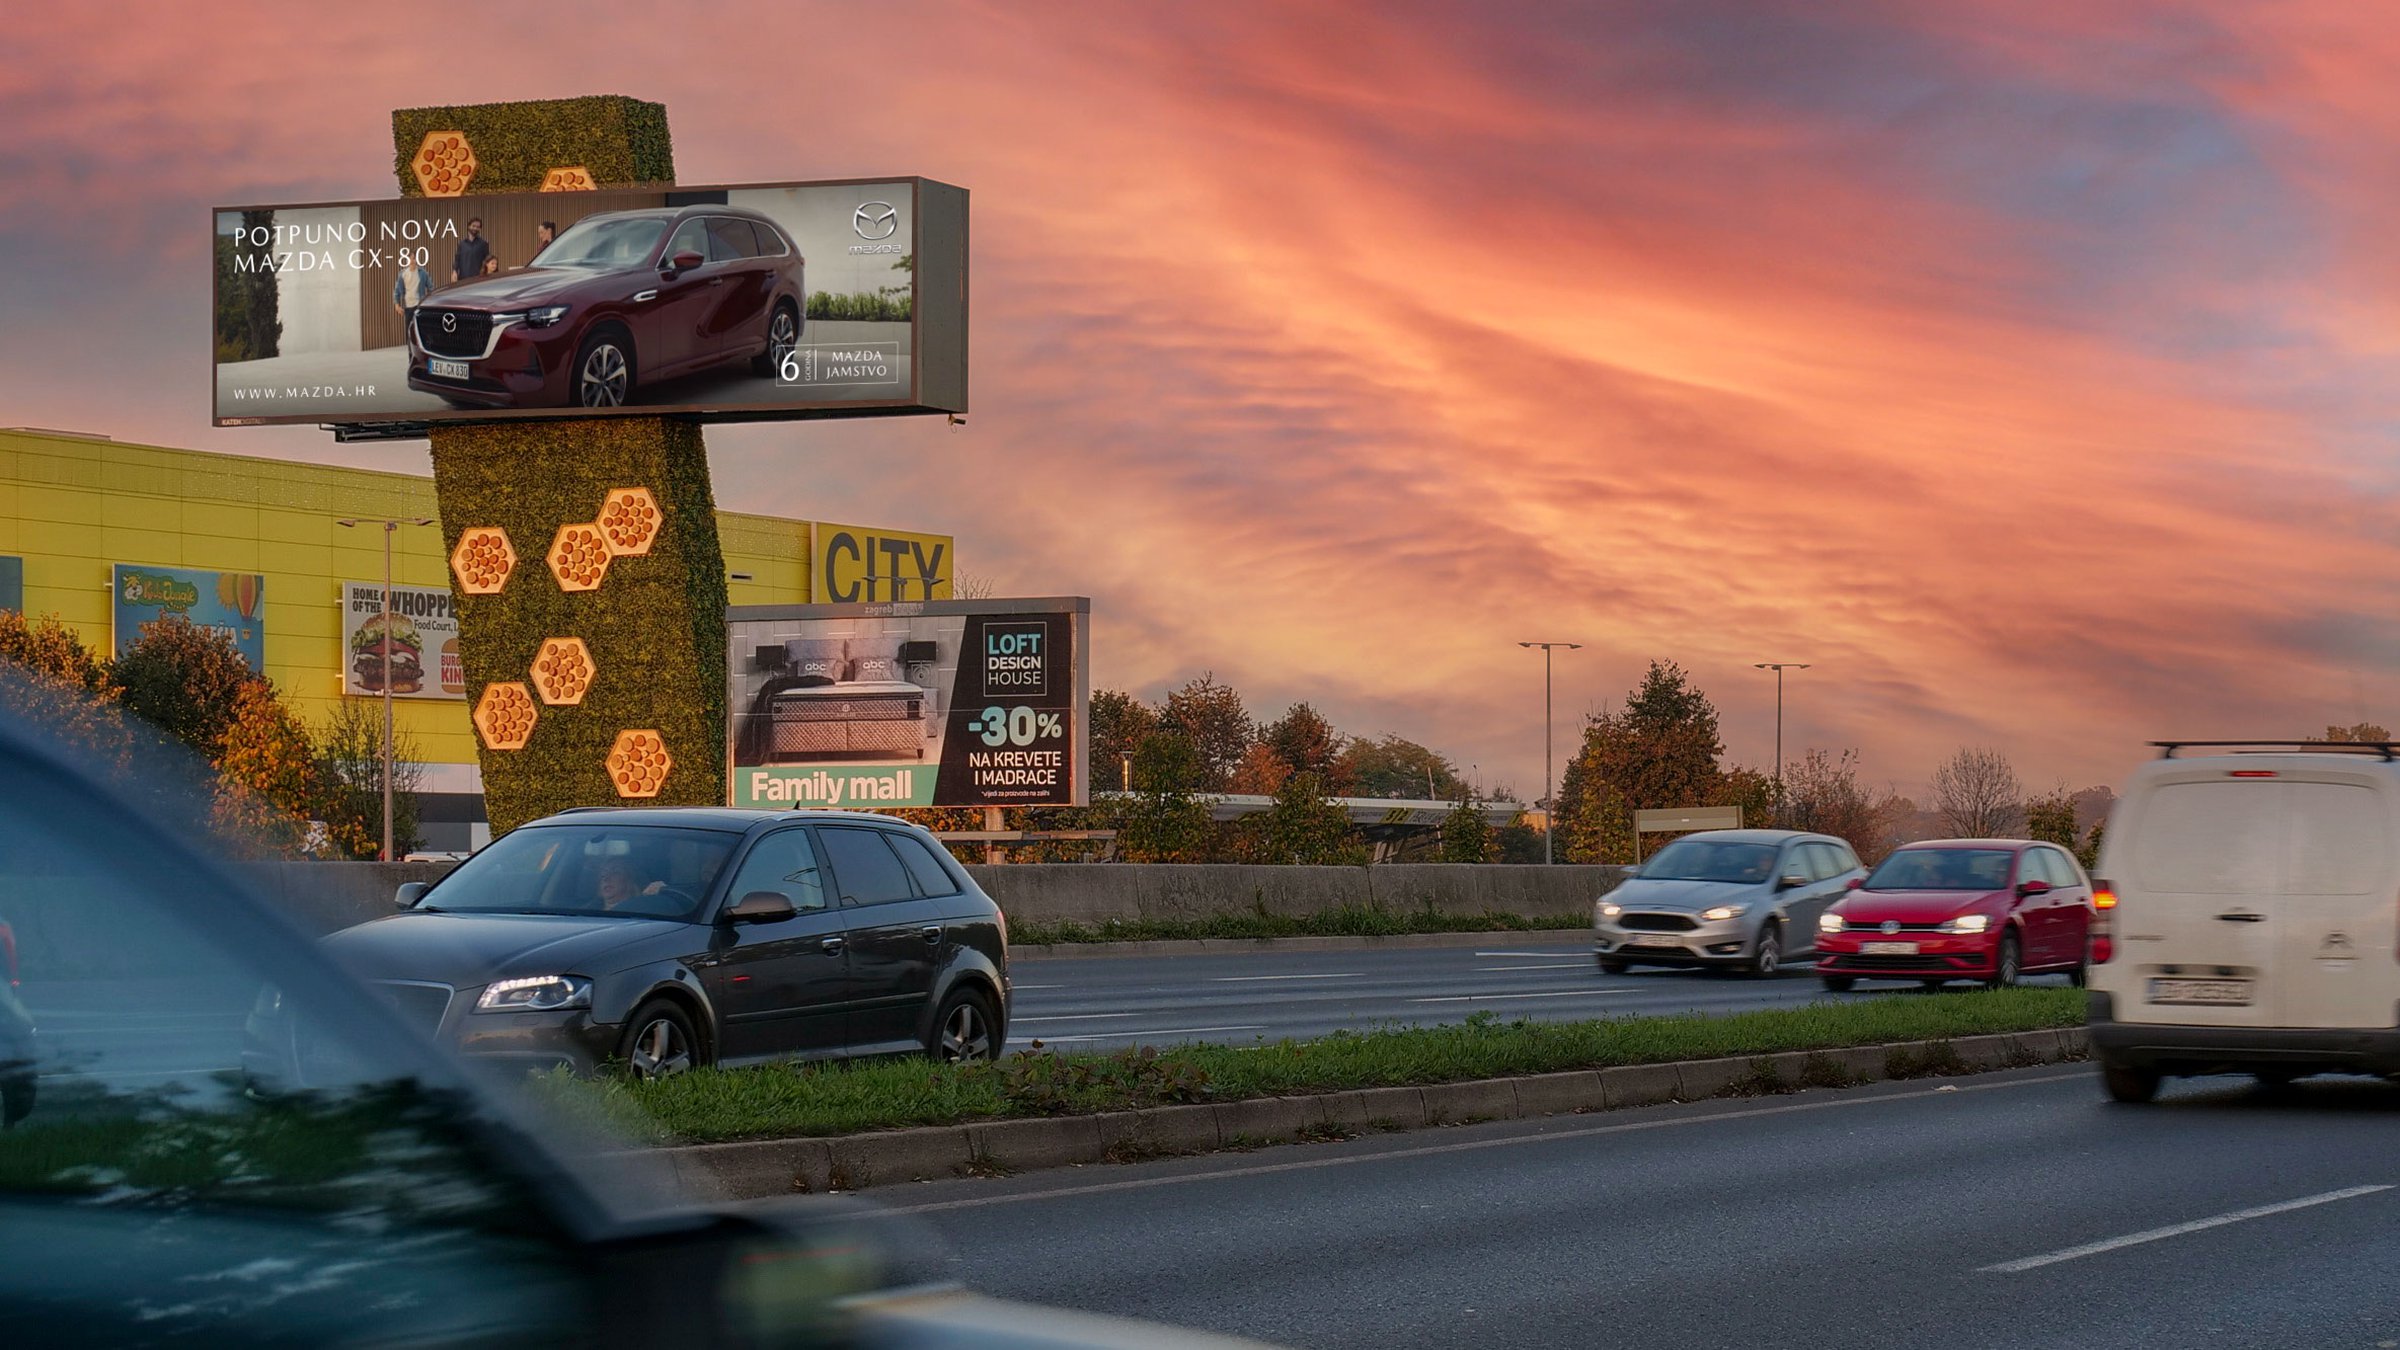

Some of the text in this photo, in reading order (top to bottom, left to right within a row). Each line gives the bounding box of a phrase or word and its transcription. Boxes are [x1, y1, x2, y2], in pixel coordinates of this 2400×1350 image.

[234, 218, 458, 247] POTPUNO NOVA
[234, 246, 430, 274] MAZDA CX-80
[832, 350, 883, 362] MAZDA
[781, 350, 800, 381] 6
[826, 365, 887, 379] JAMSTVO
[233, 385, 376, 399] WWW.MAZDA.HR
[825, 532, 945, 603] CITY
[352, 587, 380, 601] HOME
[352, 600, 382, 613] OF THE
[381, 591, 457, 618] WHOPPE
[414, 619, 431, 630] Food
[988, 633, 1041, 655] LOFT
[441, 655, 461, 667] BURG
[805, 662, 827, 671] abc
[863, 660, 885, 669] abc
[988, 656, 1041, 670] DESIGN
[441, 667, 463, 683] KIN
[988, 671, 1041, 685] HOUSE
[968, 706, 1062, 747] -30%
[969, 751, 1062, 768] NA KREVETE
[974, 769, 1057, 786] I MADRACE
[752, 770, 912, 805] Family mall
